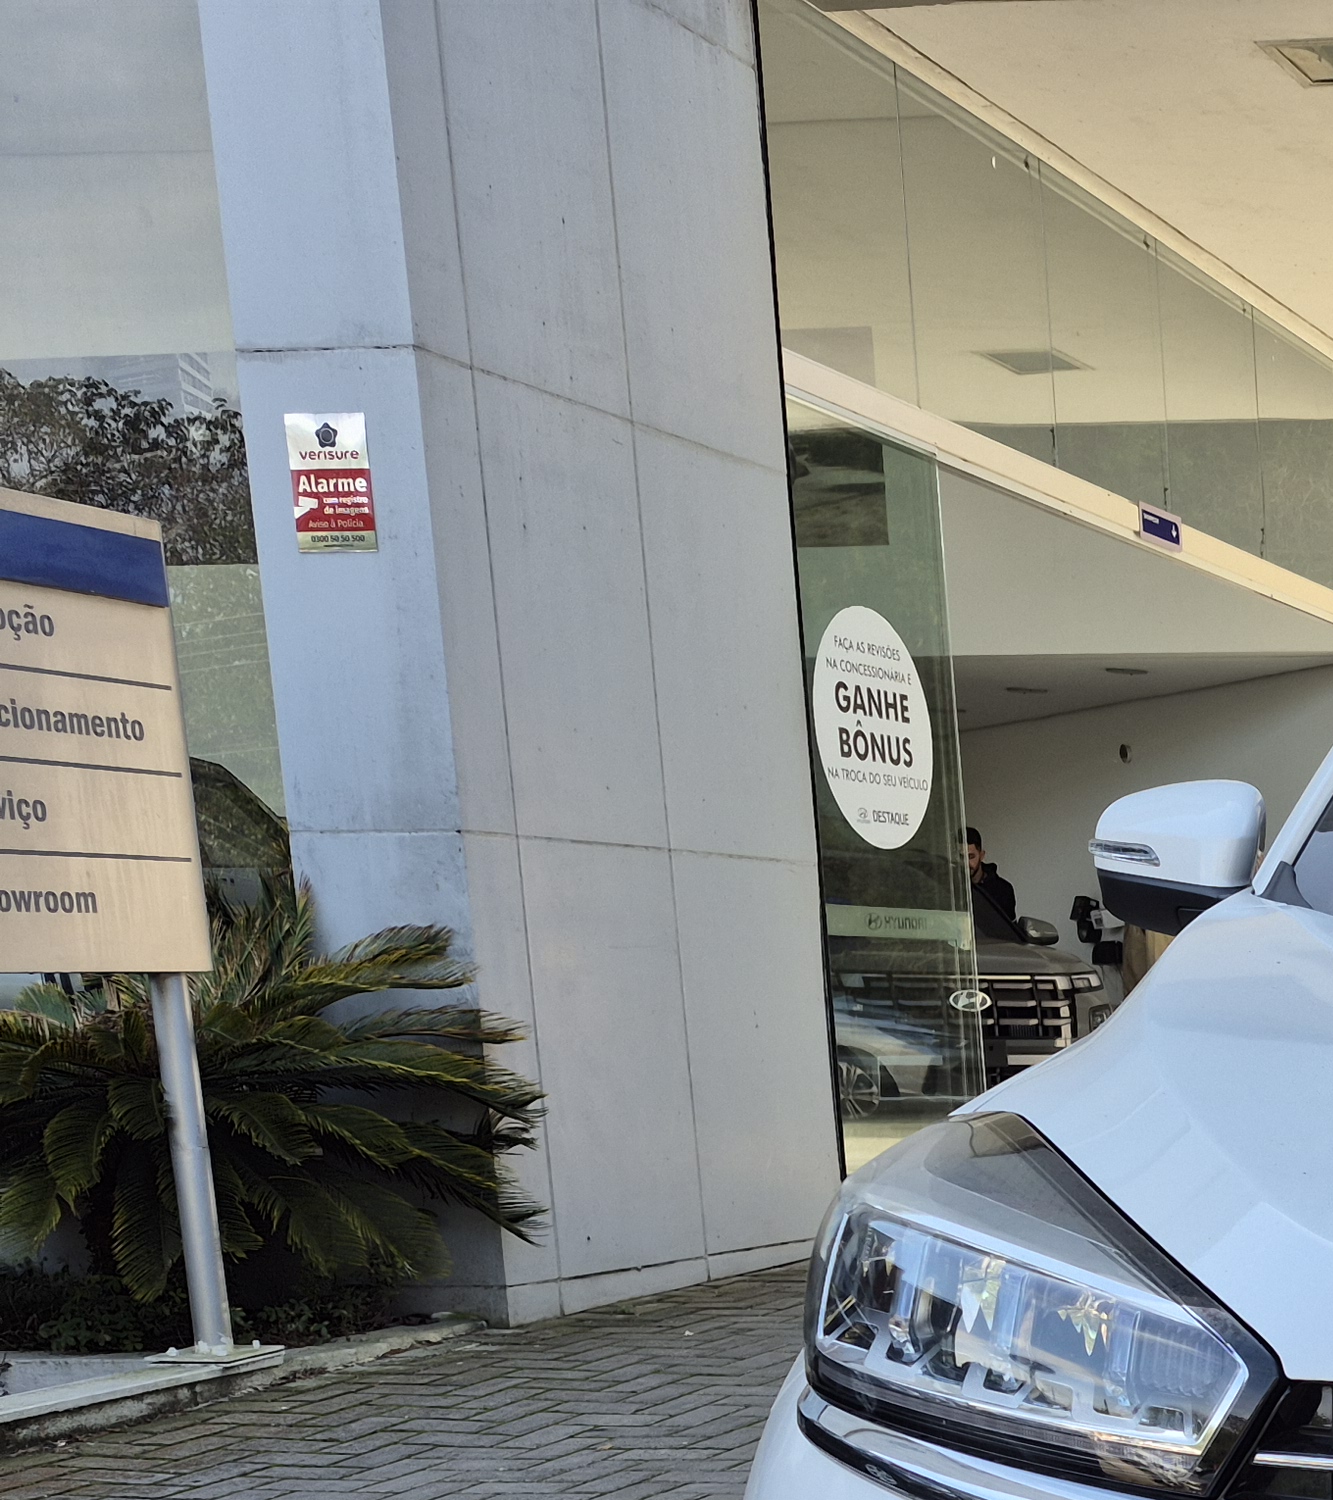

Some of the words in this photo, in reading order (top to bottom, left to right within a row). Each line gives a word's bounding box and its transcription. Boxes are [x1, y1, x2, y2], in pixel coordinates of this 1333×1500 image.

[299, 450, 360, 460] verisure
[298, 474, 368, 493] Alarme
[834, 635, 854, 653] FAÇA
[856, 641, 866, 654] AS
[826, 656, 839, 671] NA
[840, 659, 906, 684] CONCESSIONÁRIA
[907, 673, 912, 686] E
[834, 681, 911, 724] GANHE
[838, 719, 914, 769] BÔNUS
[827, 767, 840, 780] NA
[841, 768, 867, 783] TROCA
[869, 772, 881, 785] DO
[882, 774, 897, 787] SEU
[898, 774, 929, 791] VEÍCULO
[872, 809, 909, 826] DESTAQUE
